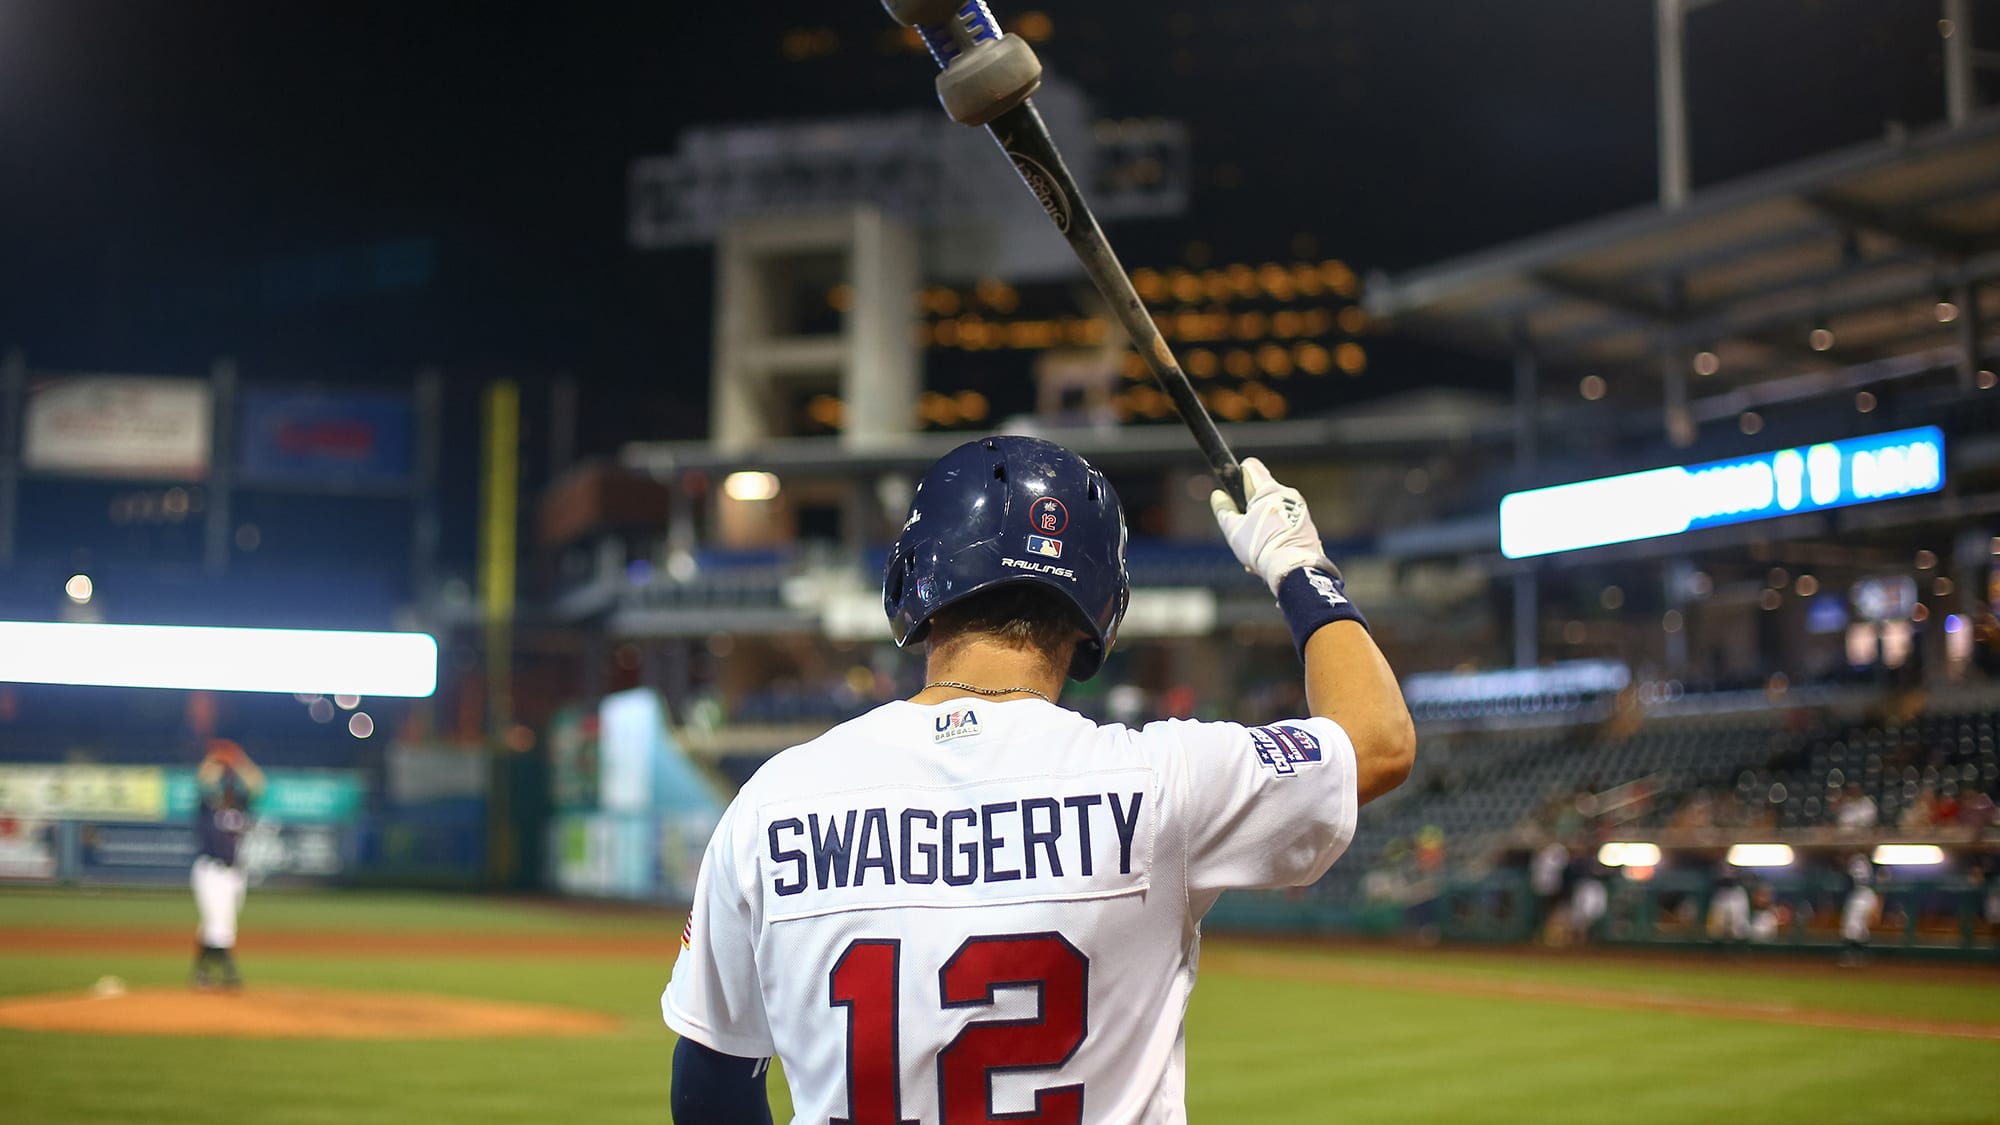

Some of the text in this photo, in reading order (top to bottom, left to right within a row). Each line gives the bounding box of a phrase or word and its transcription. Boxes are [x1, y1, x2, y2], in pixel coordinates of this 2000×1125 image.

[1041, 513, 1056, 531] 12
[1001, 557, 1074, 579] RAWLINGS
[768, 792, 1143, 896] SWAGGERTY
[829, 930, 1090, 1125] 12
